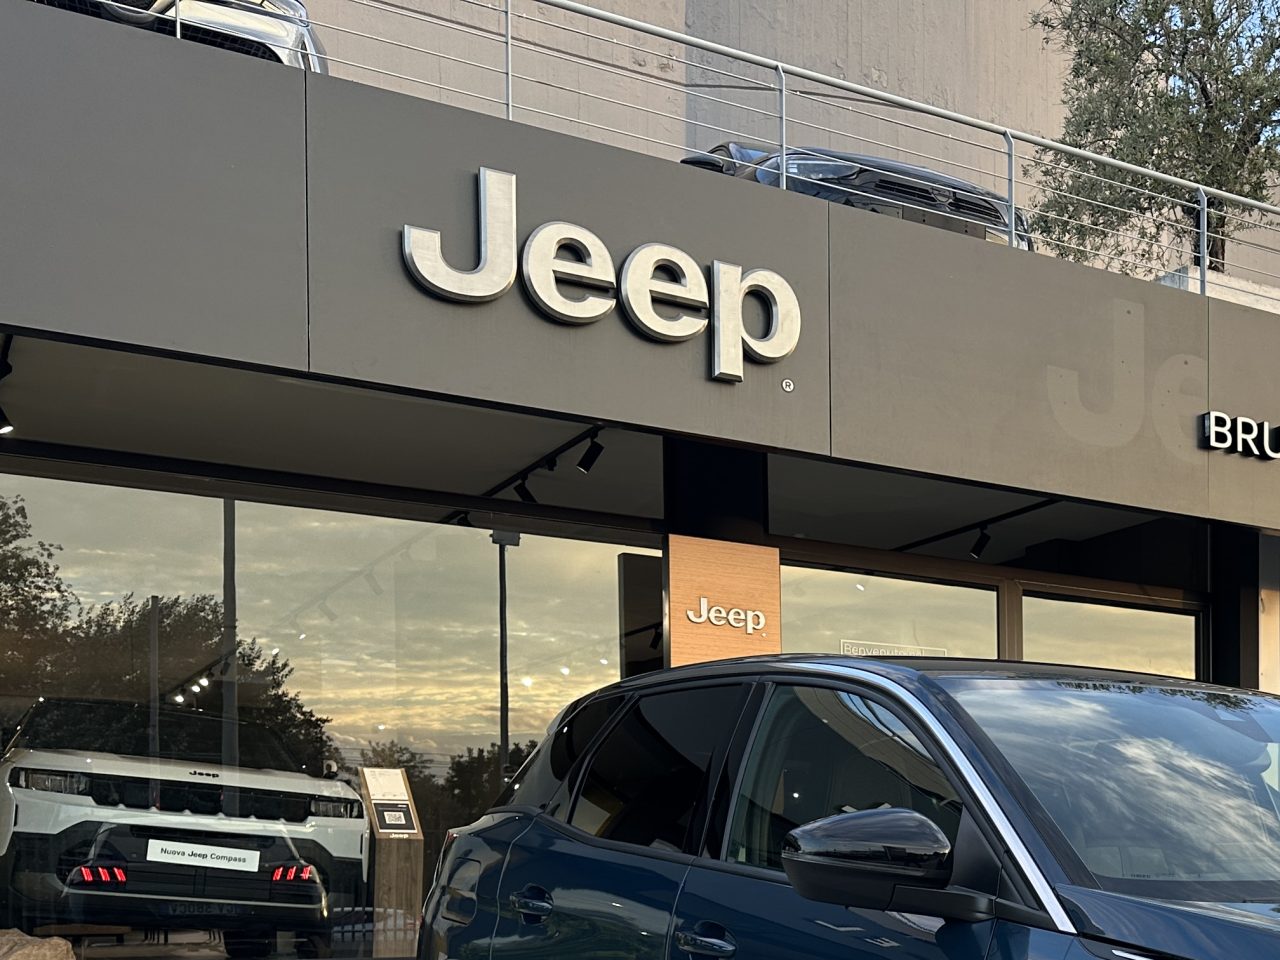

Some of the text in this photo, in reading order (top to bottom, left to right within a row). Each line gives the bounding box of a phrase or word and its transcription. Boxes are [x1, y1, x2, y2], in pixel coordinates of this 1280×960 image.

[402, 166, 802, 384] Jeep
[686, 596, 767, 635] Jeep
[189, 770, 220, 779] Jeep
[160, 847, 247, 864] Nuova Jeep Compass
